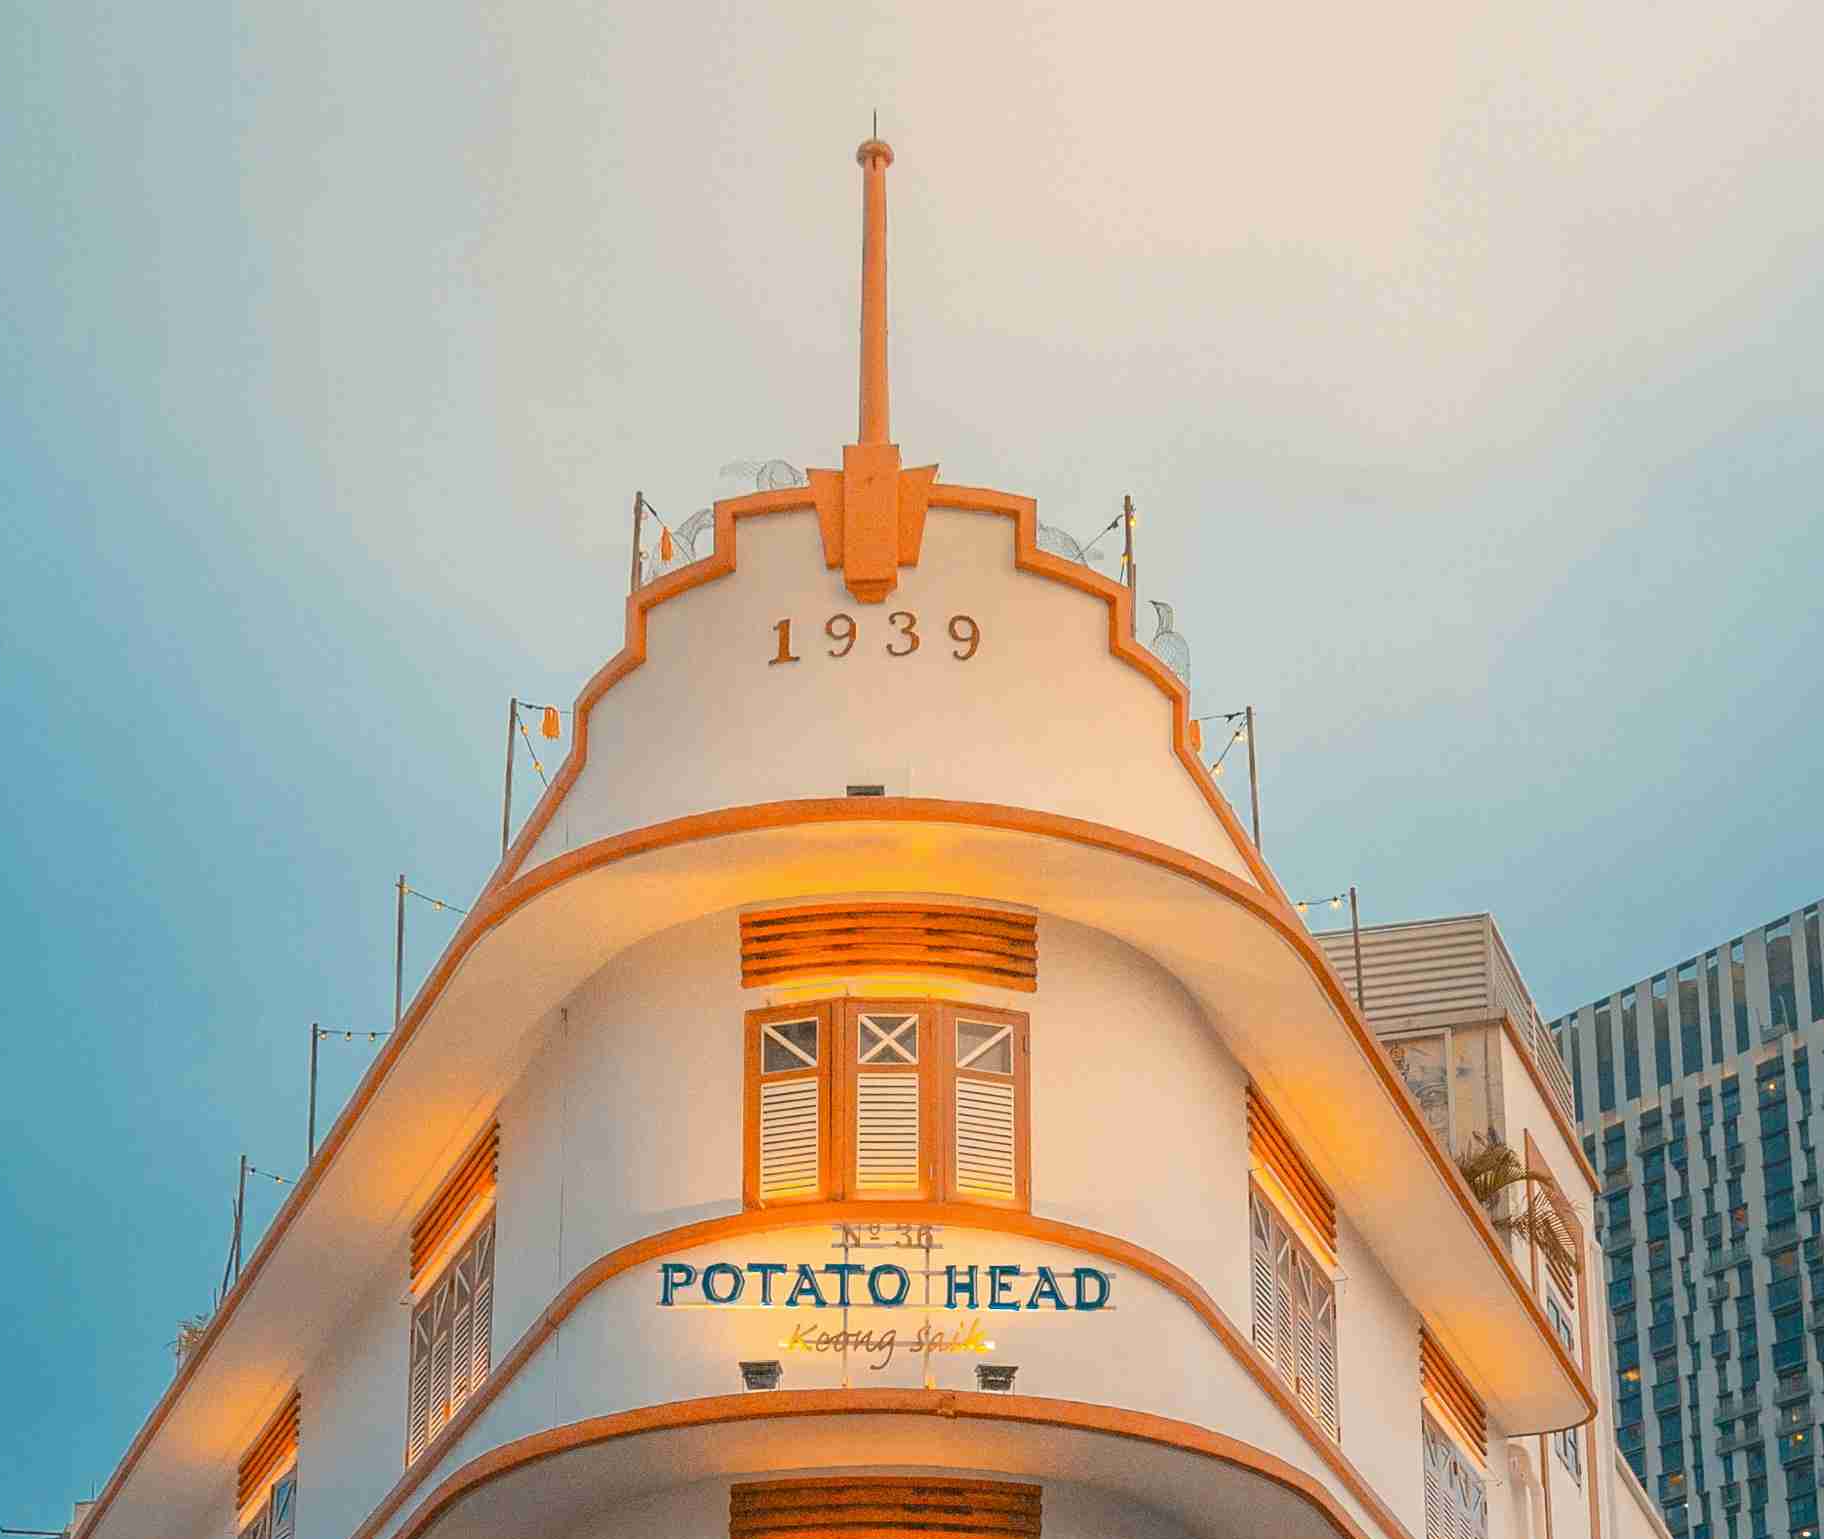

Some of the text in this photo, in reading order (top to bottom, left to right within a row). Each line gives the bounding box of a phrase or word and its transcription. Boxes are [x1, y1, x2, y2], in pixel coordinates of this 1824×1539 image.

[768, 610, 981, 667] 1939
[658, 1262, 1112, 1312] POTATO HEAD
[789, 1322, 897, 1371] Keong
